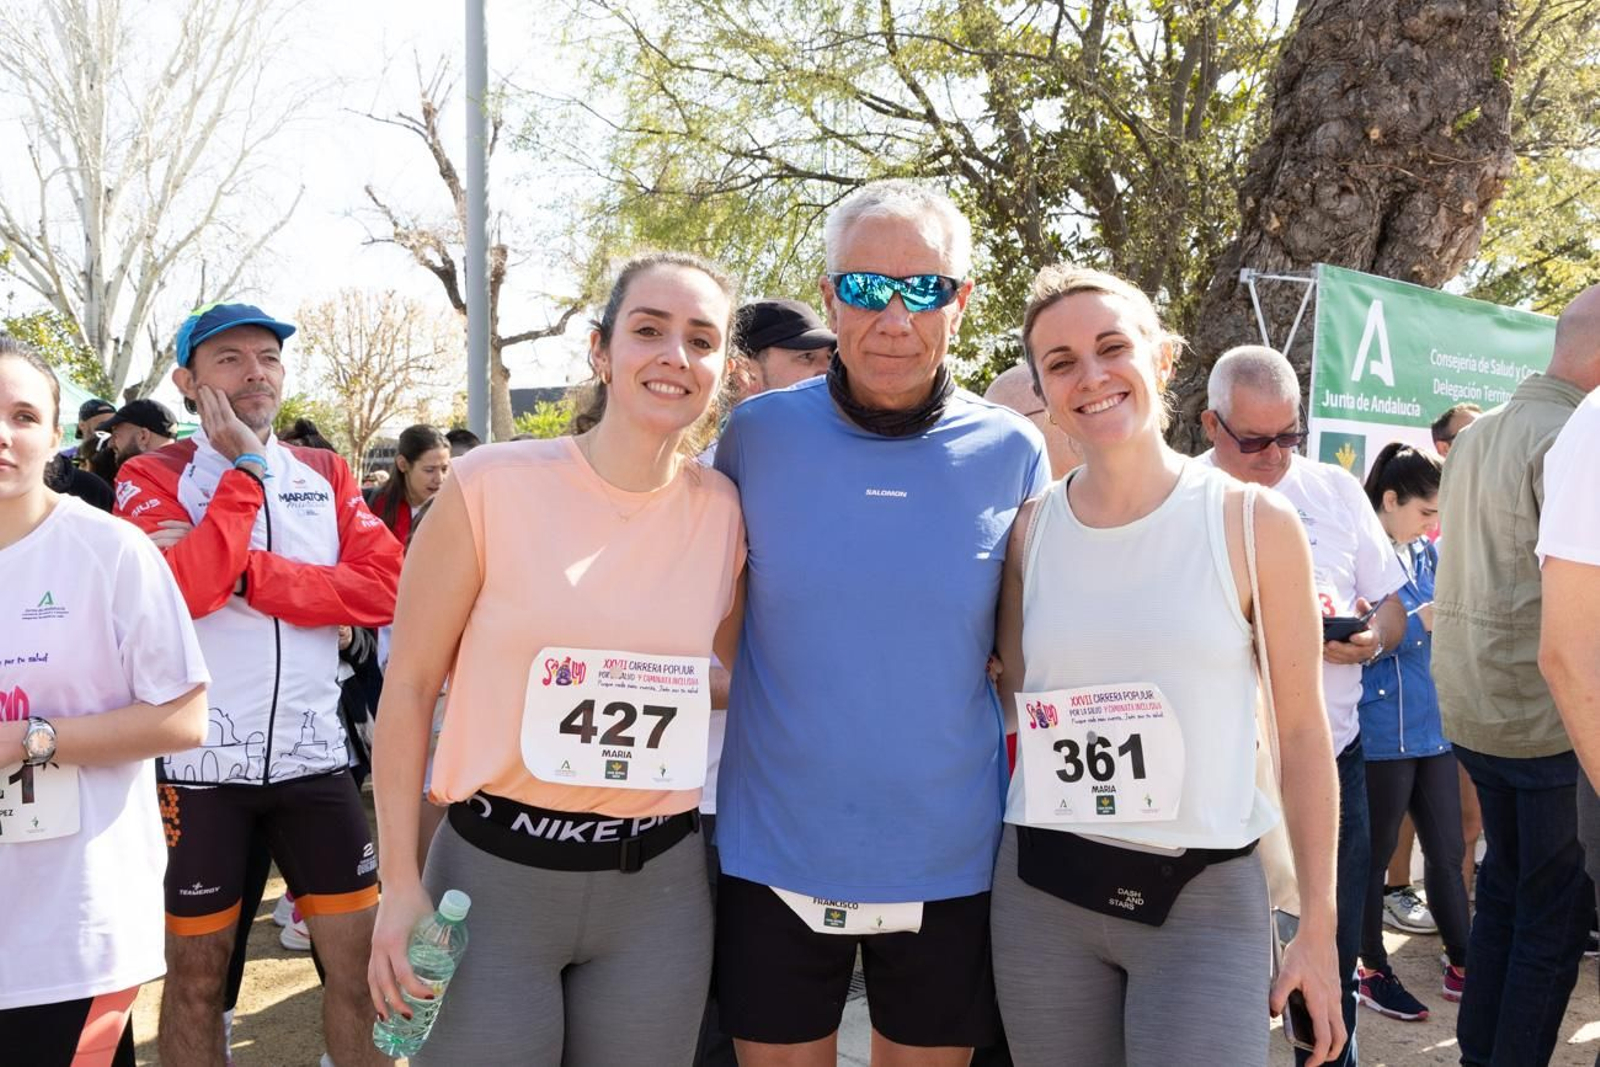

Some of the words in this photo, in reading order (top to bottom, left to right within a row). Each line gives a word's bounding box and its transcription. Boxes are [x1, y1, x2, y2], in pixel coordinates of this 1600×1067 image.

[1430, 348, 1477, 373] Consejería
[1478, 356, 1489, 374] de
[1490, 359, 1515, 377] Salud
[1515, 366, 1521, 382] y
[1433, 378, 1482, 401] Delegación
[1321, 389, 1355, 409] Junta
[1356, 393, 1369, 411] de
[1370, 395, 1420, 417] Andalucía
[278, 491, 329, 503] MARATÓN
[866, 488, 907, 498] SALOMON
[28, 652, 48, 663] salud
[628, 660, 662, 673] CARRERA
[1070, 694, 1093, 707] XXVII
[1093, 692, 1122, 704] CARRERA
[559, 699, 678, 749] 427
[601, 749, 632, 759] MARIA
[1053, 733, 1146, 783] 361
[1091, 785, 1117, 794] MARIA
[511, 812, 624, 843] NIKE
[631, 816, 669, 837] P
[1118, 888, 1142, 898] DASH
[813, 897, 859, 910] FRANCISCO
[1109, 898, 1135, 910] STARS
[1126, 896, 1144, 906] AND
